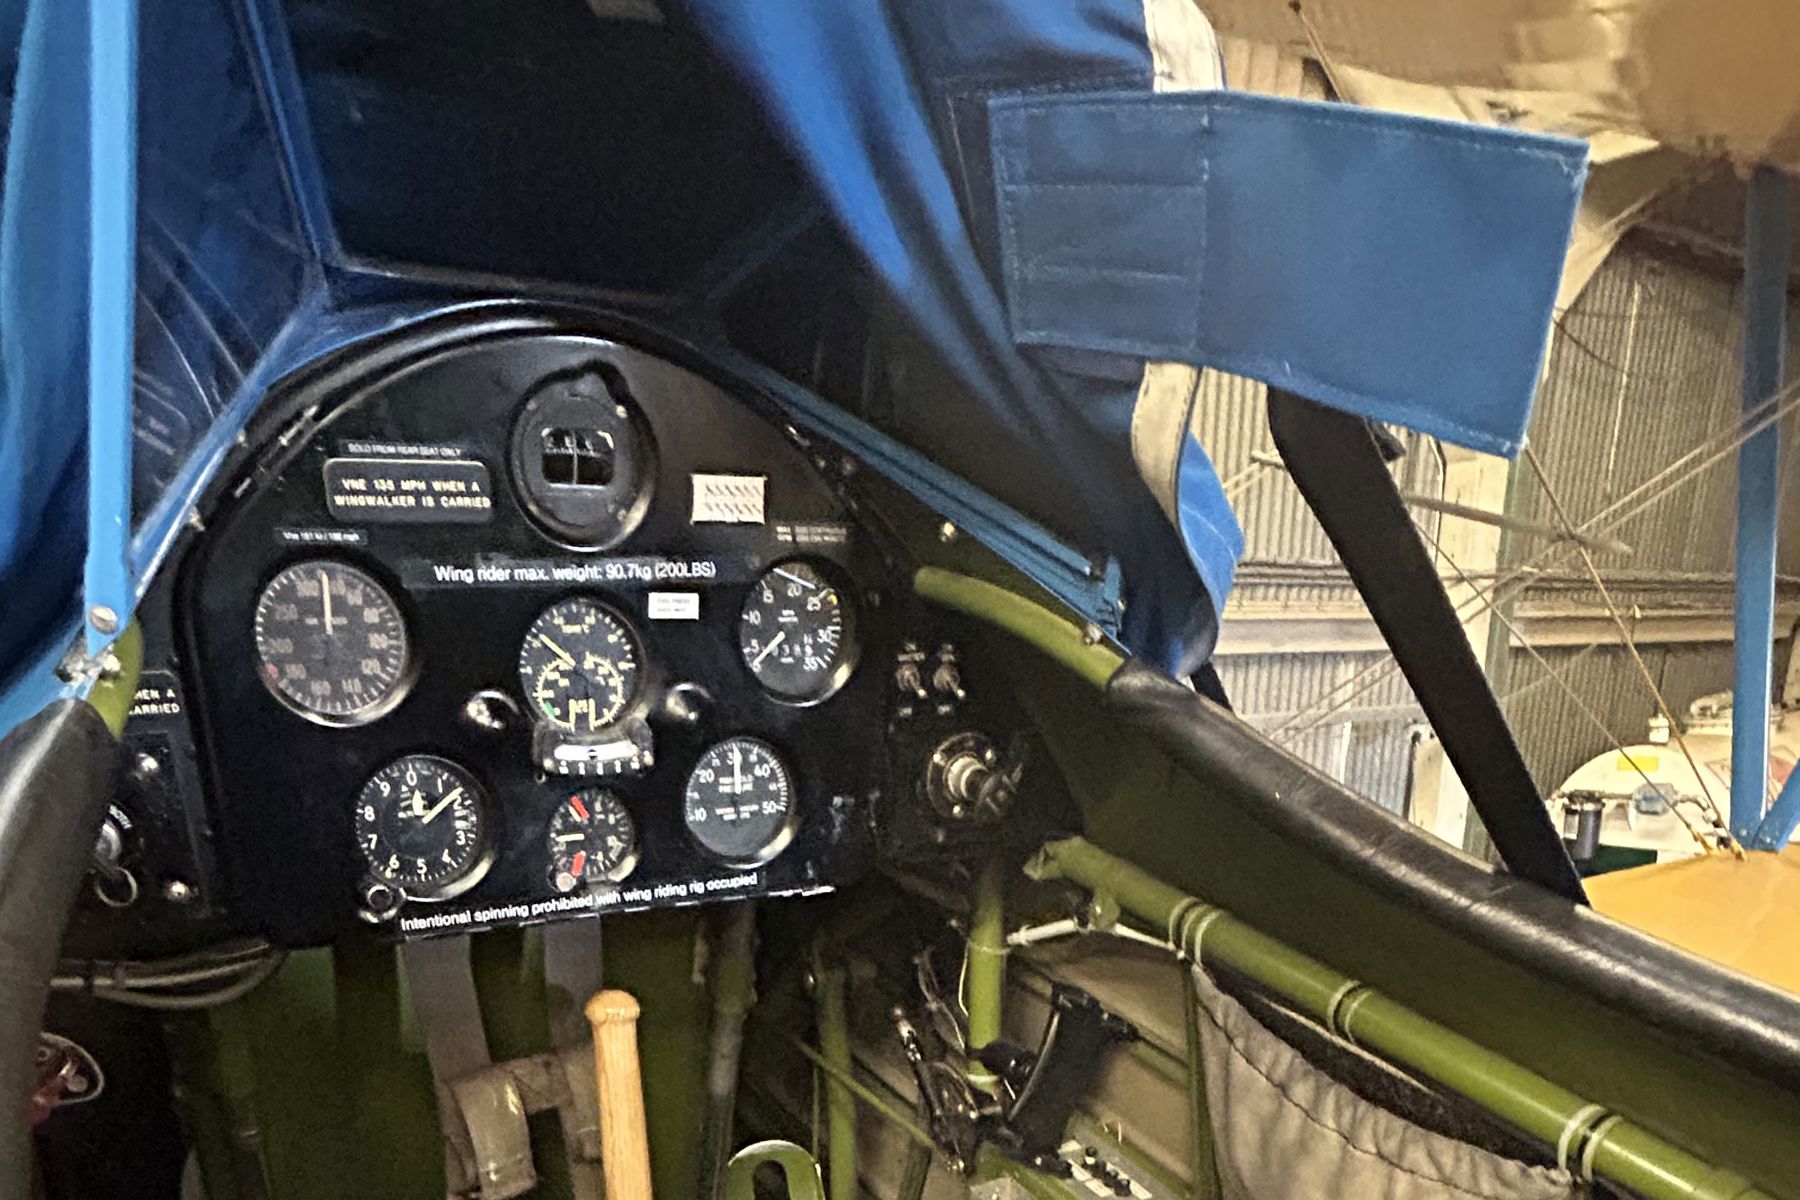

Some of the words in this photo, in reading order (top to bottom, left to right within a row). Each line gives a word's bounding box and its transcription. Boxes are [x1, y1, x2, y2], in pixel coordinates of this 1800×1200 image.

[342, 479, 367, 491] VNE
[401, 480, 426, 492] MPH
[432, 481, 466, 493] WHEN
[472, 482, 480, 492] A
[334, 496, 416, 508] WINGWALKER
[422, 496, 435, 508] IS
[441, 497, 491, 509] CARRIED
[434, 564, 474, 584] Wing
[477, 565, 511, 581] rider
[514, 566, 549, 581] max.
[552, 564, 601, 582] weight:
[606, 563, 651, 581] 90.7kg
[655, 561, 717, 579] (200LBS)
[748, 610, 761, 625] 10
[134, 688, 160, 700] HEN
[166, 688, 176, 698] A
[128, 702, 180, 715] ARRIED
[406, 770, 417, 786] 0
[699, 768, 715, 783] 20
[380, 781, 391, 797] 9
[364, 805, 375, 821] 8
[695, 807, 706, 821] 10
[762, 801, 778, 815] 50
[368, 834, 378, 849] 7
[456, 831, 466, 845] 3
[389, 854, 400, 869] 6
[417, 858, 427, 874] 5
[401, 910, 472, 931] Intentional
[474, 904, 529, 923] spinning
[532, 896, 593, 915] prohibited
[596, 890, 621, 905] with
[623, 888, 652, 902] wing
[654, 883, 687, 898] riding
[689, 880, 705, 894] rig
[705, 872, 757, 891] occupied
